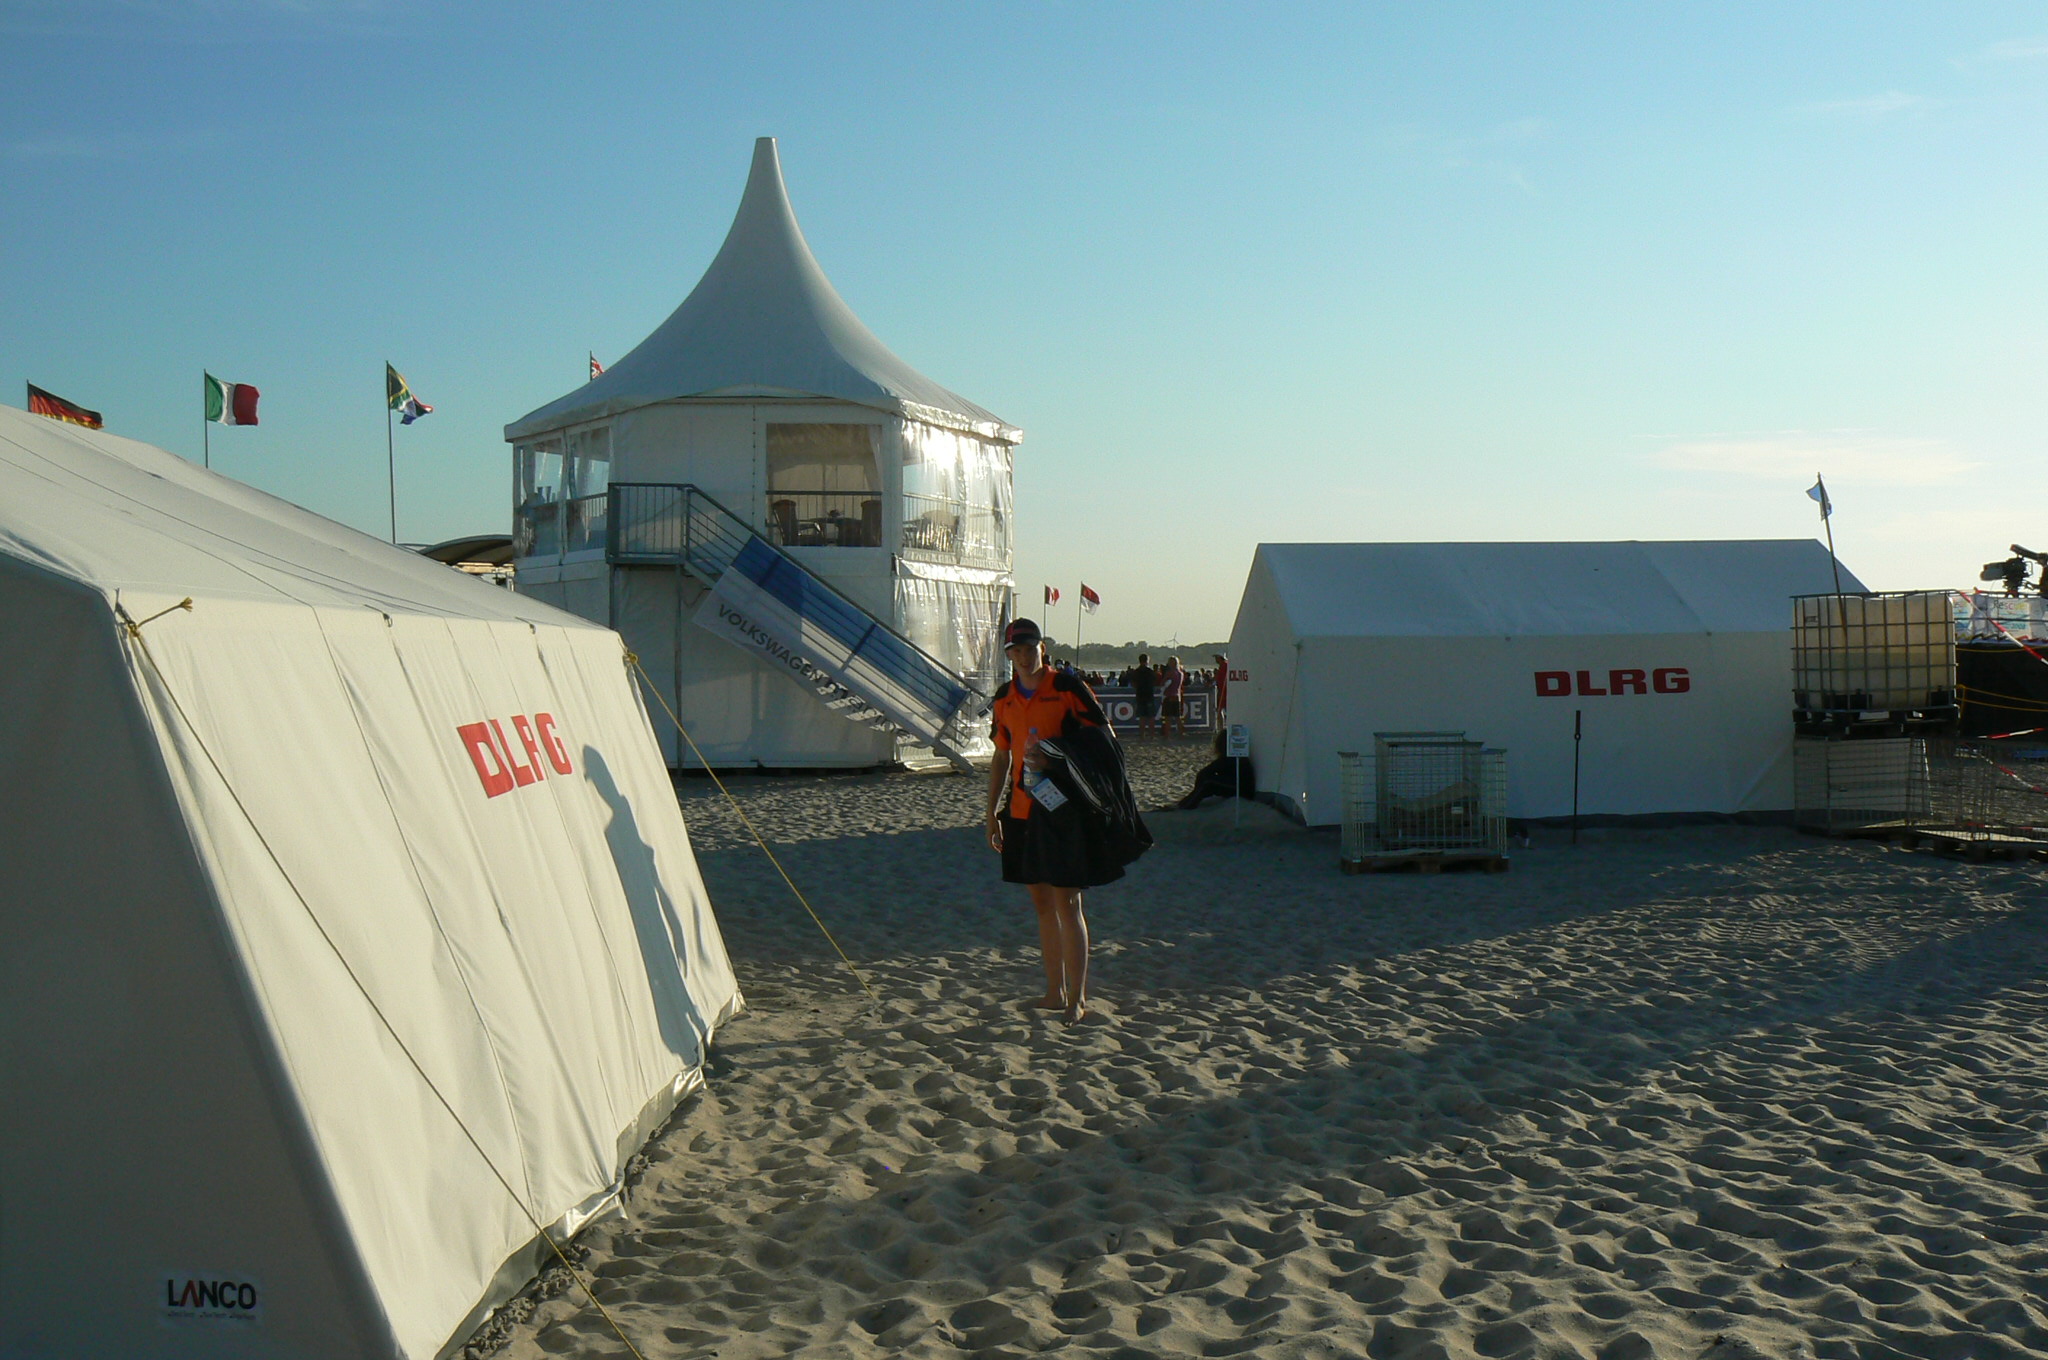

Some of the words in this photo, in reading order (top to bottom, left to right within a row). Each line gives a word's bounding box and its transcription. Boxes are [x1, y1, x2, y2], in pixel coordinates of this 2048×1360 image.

[718, 604, 824, 681] VOLKSWAGEN
[1229, 670, 1249, 682] DLRG
[1534, 667, 1690, 697] DLRG
[456, 712, 573, 799] DLRG
[168, 1279, 257, 1309] LANCO
